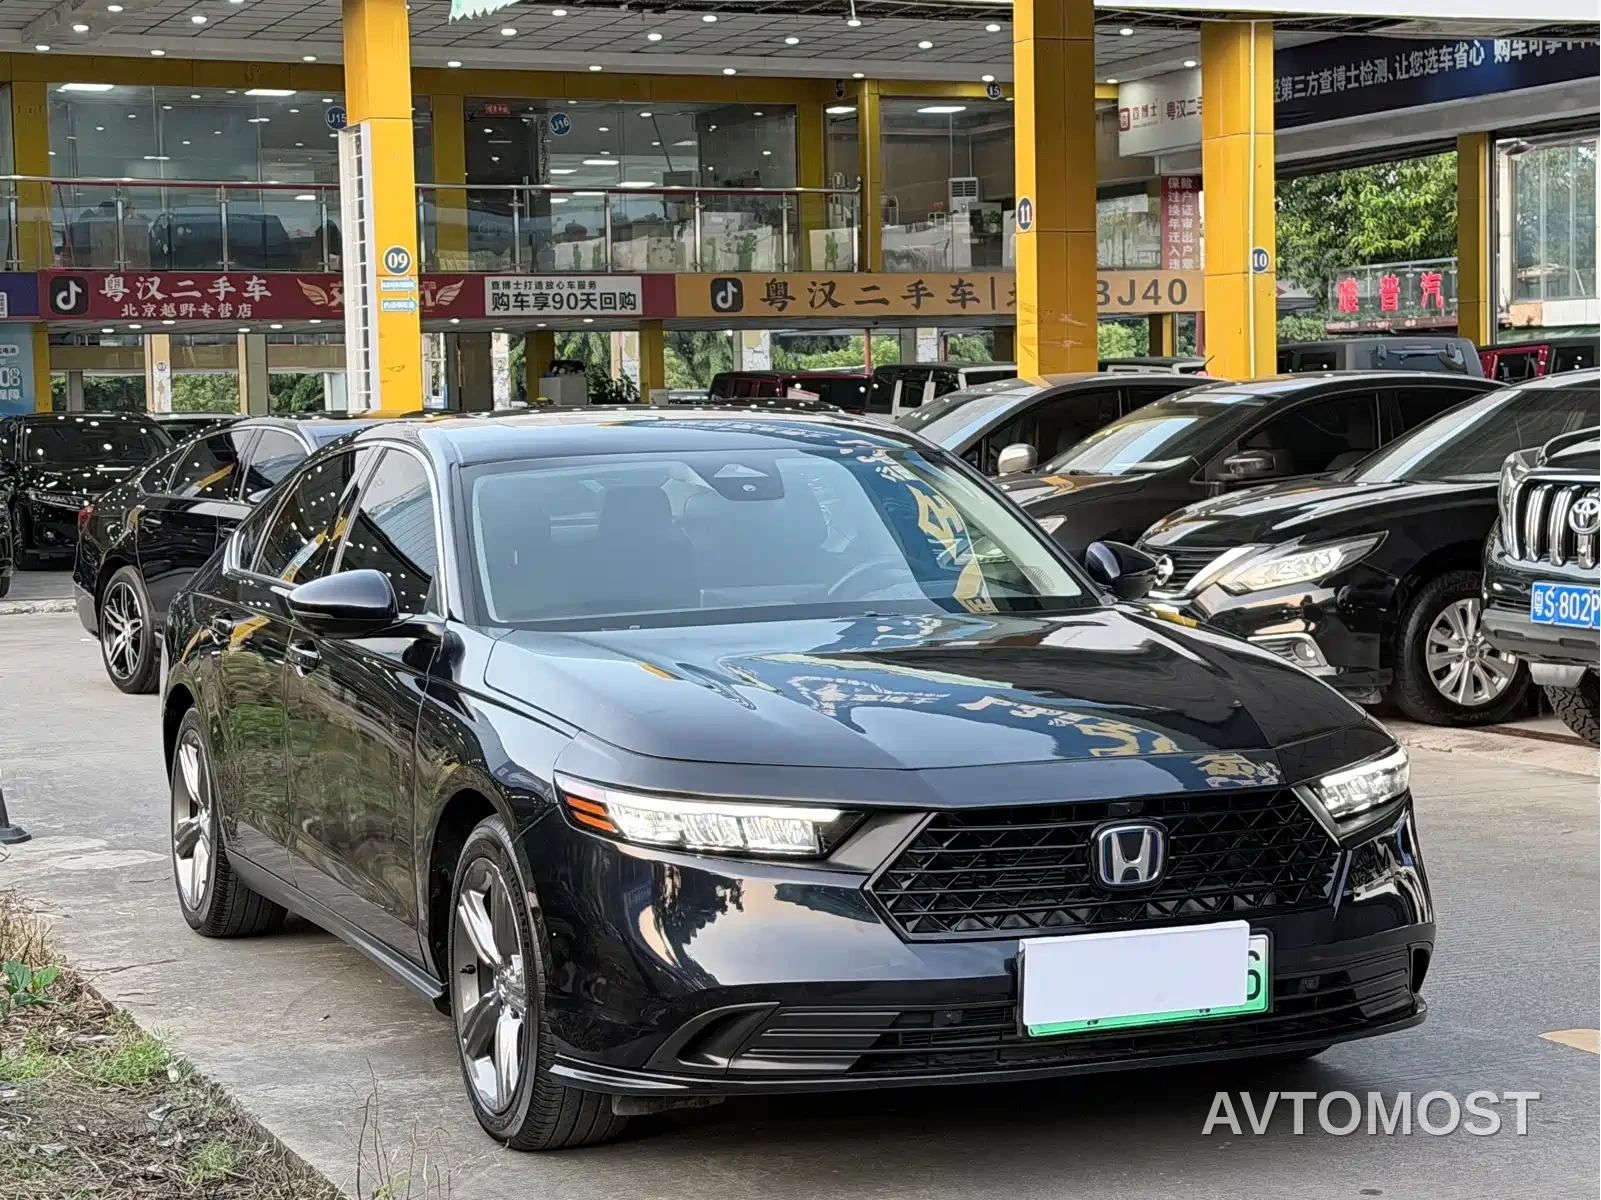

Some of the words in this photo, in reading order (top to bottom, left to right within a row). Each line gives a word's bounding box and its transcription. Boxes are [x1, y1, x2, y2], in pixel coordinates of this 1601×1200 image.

[551, 117, 570, 131] U16
[1168, 177, 1193, 189] 保险
[1168, 191, 1193, 203] 过户
[1020, 204, 1031, 224] 11
[1168, 204, 1193, 216] 换证
[1168, 218, 1193, 229] 年审
[1168, 245, 1193, 257] 入户
[388, 253, 408, 269] 09
[1254, 253, 1267, 268] 10
[99, 273, 272, 302] 粤汉二手车
[491, 280, 597, 290] 查博士打造放心车服务
[492, 291, 637, 312] 购车享90天回购
[121, 302, 253, 318] 北京越野专营店
